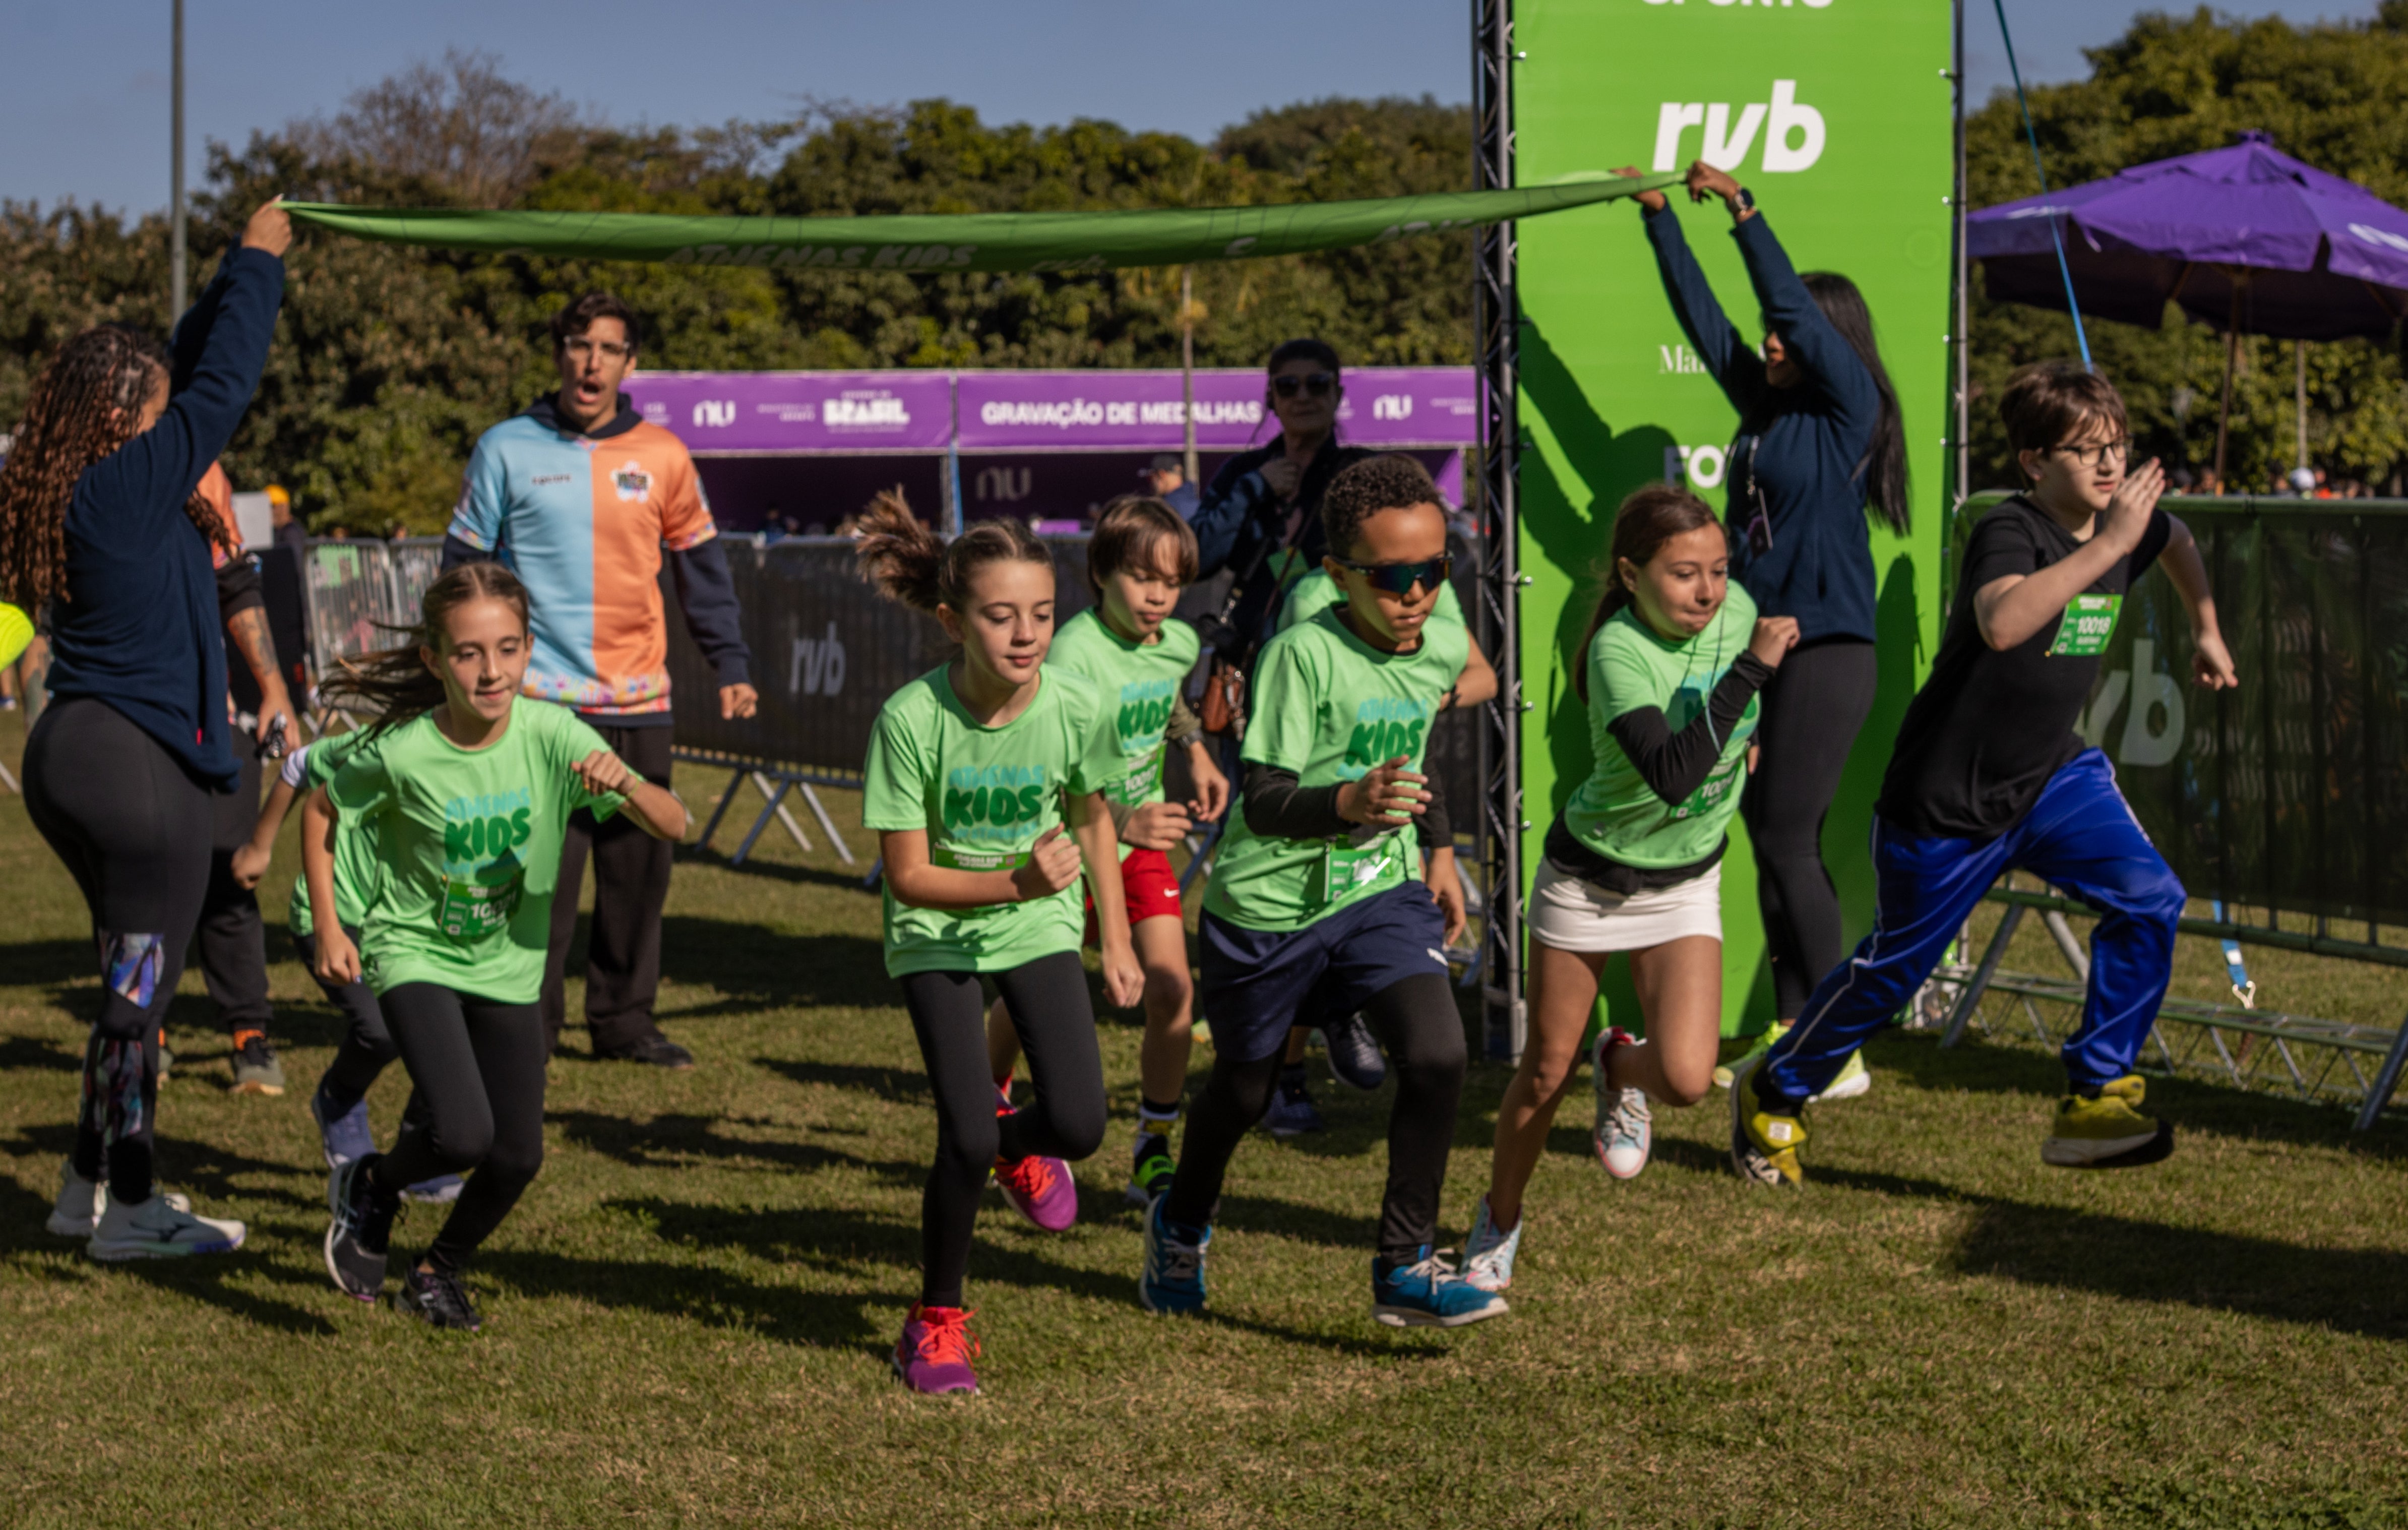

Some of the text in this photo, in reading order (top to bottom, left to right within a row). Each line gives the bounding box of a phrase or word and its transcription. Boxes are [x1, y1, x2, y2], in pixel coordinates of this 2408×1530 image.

[1652, 79, 1826, 173] rvb
[871, 244, 977, 268] KIDS
[981, 398, 1104, 429] GRAVAÇÃO
[1107, 402, 1137, 425] DE
[789, 621, 846, 696] rvb
[1118, 695, 1172, 739] KIDS
[2072, 638, 2185, 766] vb
[1344, 718, 1426, 767] KIDS
[948, 765, 1044, 789] ATHENAS
[445, 786, 531, 823] ATHENAS
[943, 785, 1043, 829] KIDS
[444, 807, 531, 864] KIDS
